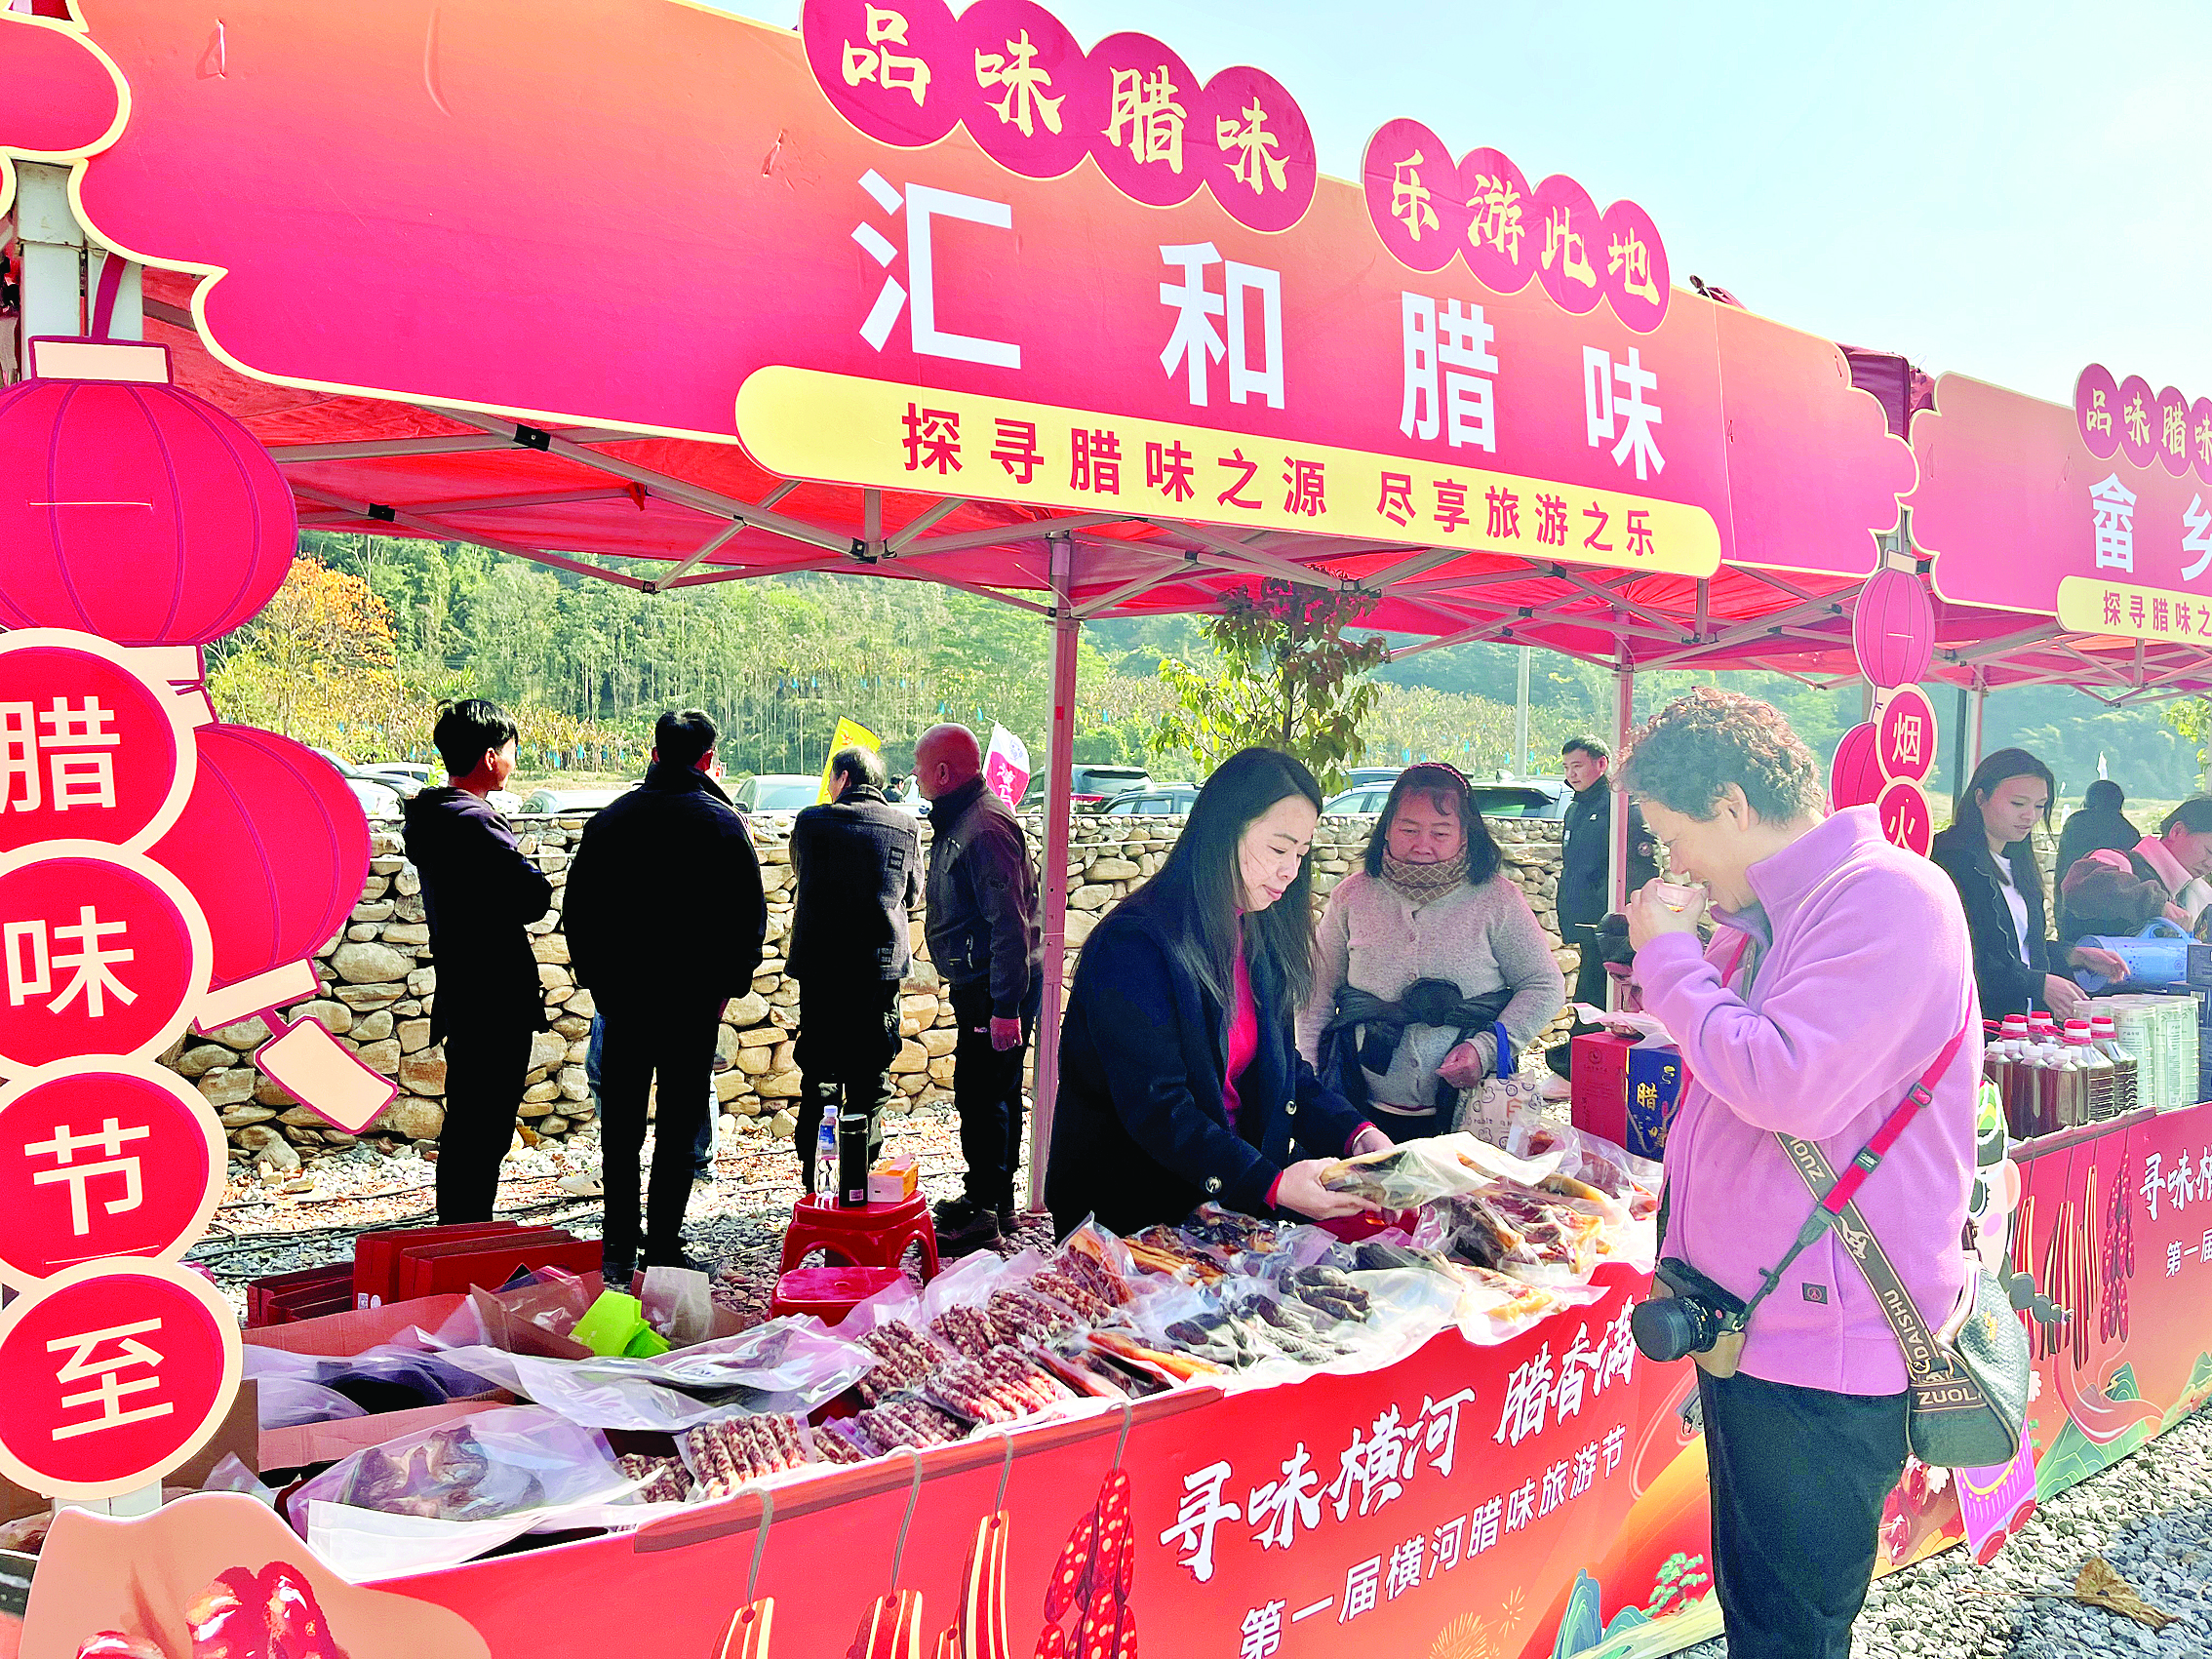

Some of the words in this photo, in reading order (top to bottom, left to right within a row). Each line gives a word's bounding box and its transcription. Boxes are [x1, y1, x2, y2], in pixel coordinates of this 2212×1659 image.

[841, 4, 1291, 194] 品味腊味
[1389, 148, 1661, 308] 乐游此地
[850, 168, 1667, 482] 汇和腊味
[901, 402, 1328, 518] 探寻腊味之源
[1375, 470, 1656, 558] 尽享旅游之乐
[2086, 387, 2212, 466] 品味腊味
[2103, 589, 2212, 637] 探寻腊味之
[1888, 711, 1922, 851] 烟火
[0, 695, 174, 1442] 腊味节至
[1883, 1288, 1931, 1360] DAISHU
[2165, 1228, 2212, 1279] 第一届
[1161, 1388, 1475, 1585] 寻味横河
[1492, 1292, 1649, 1446] 腊香满
[1916, 1387, 1983, 1405] ZUOL
[1237, 1424, 1628, 1659] 第一届横河腊味旅游节
